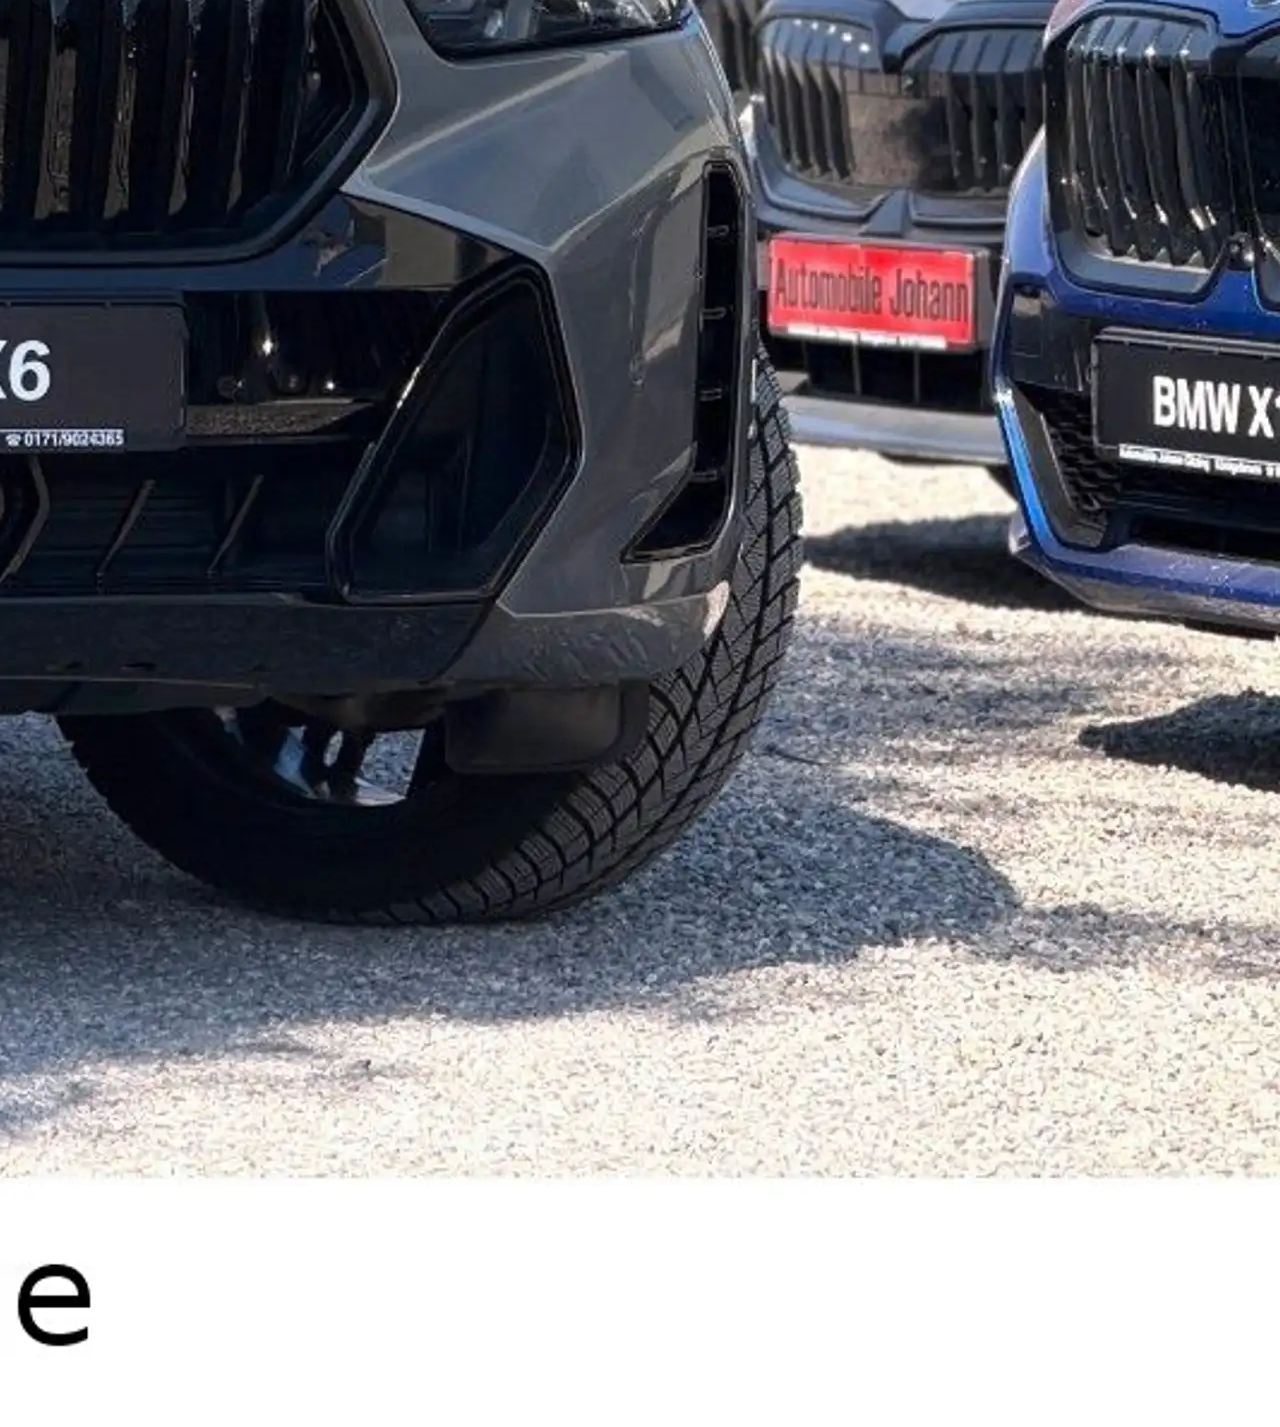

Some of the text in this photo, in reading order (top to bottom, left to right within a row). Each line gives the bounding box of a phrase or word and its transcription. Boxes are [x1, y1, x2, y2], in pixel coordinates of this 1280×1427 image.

[775, 257, 970, 324] Automobile Johann
[1153, 374, 1241, 435] BMW
